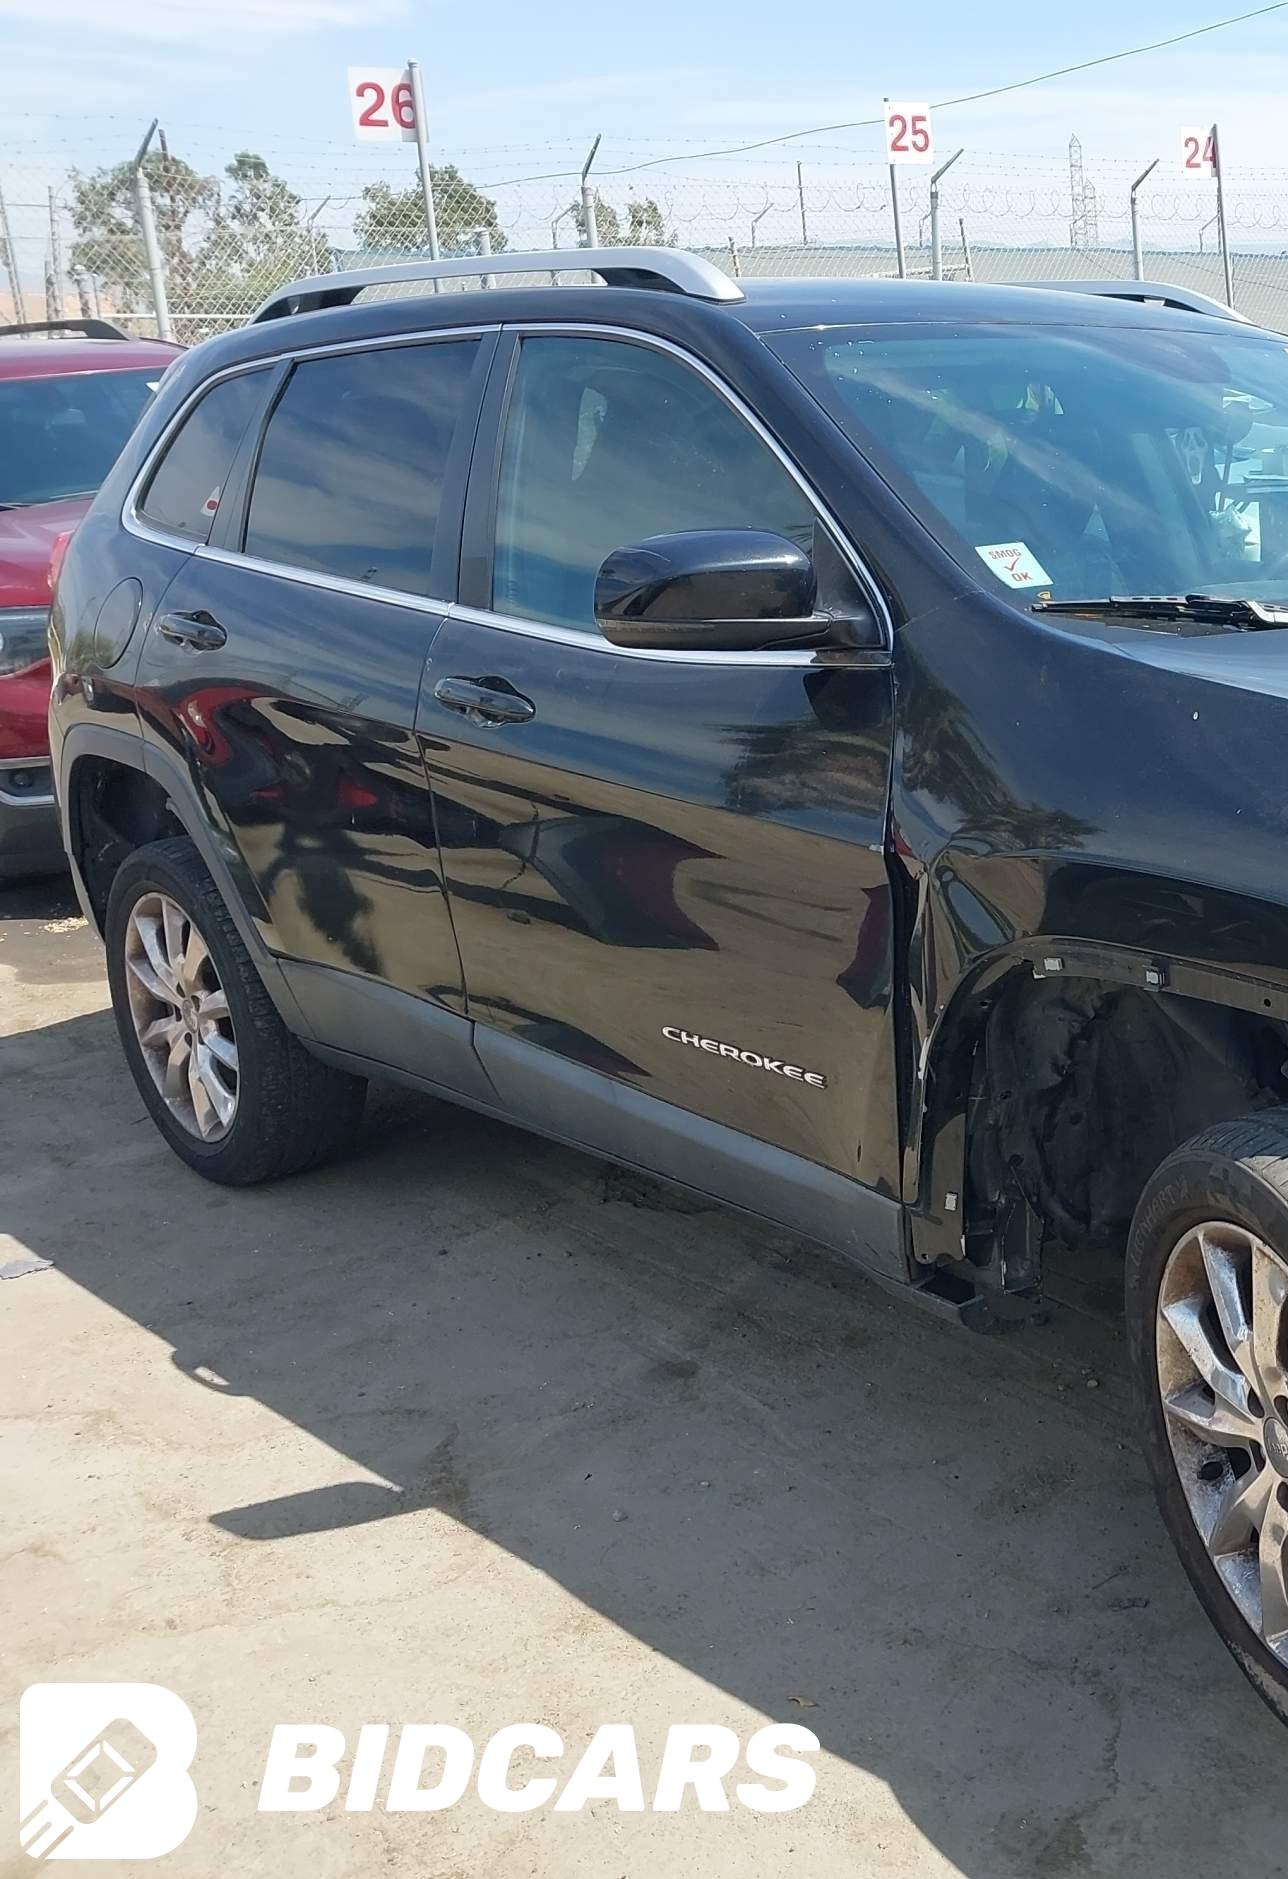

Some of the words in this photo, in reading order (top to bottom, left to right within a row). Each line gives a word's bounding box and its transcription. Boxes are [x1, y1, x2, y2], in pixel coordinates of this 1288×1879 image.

[355, 82, 417, 129] 26
[888, 114, 930, 152] 25
[1184, 136, 1217, 169] 24
[988, 548, 1022, 560] SMOG
[1011, 571, 1033, 583] OK
[661, 1025, 827, 1089] CHEROKEE
